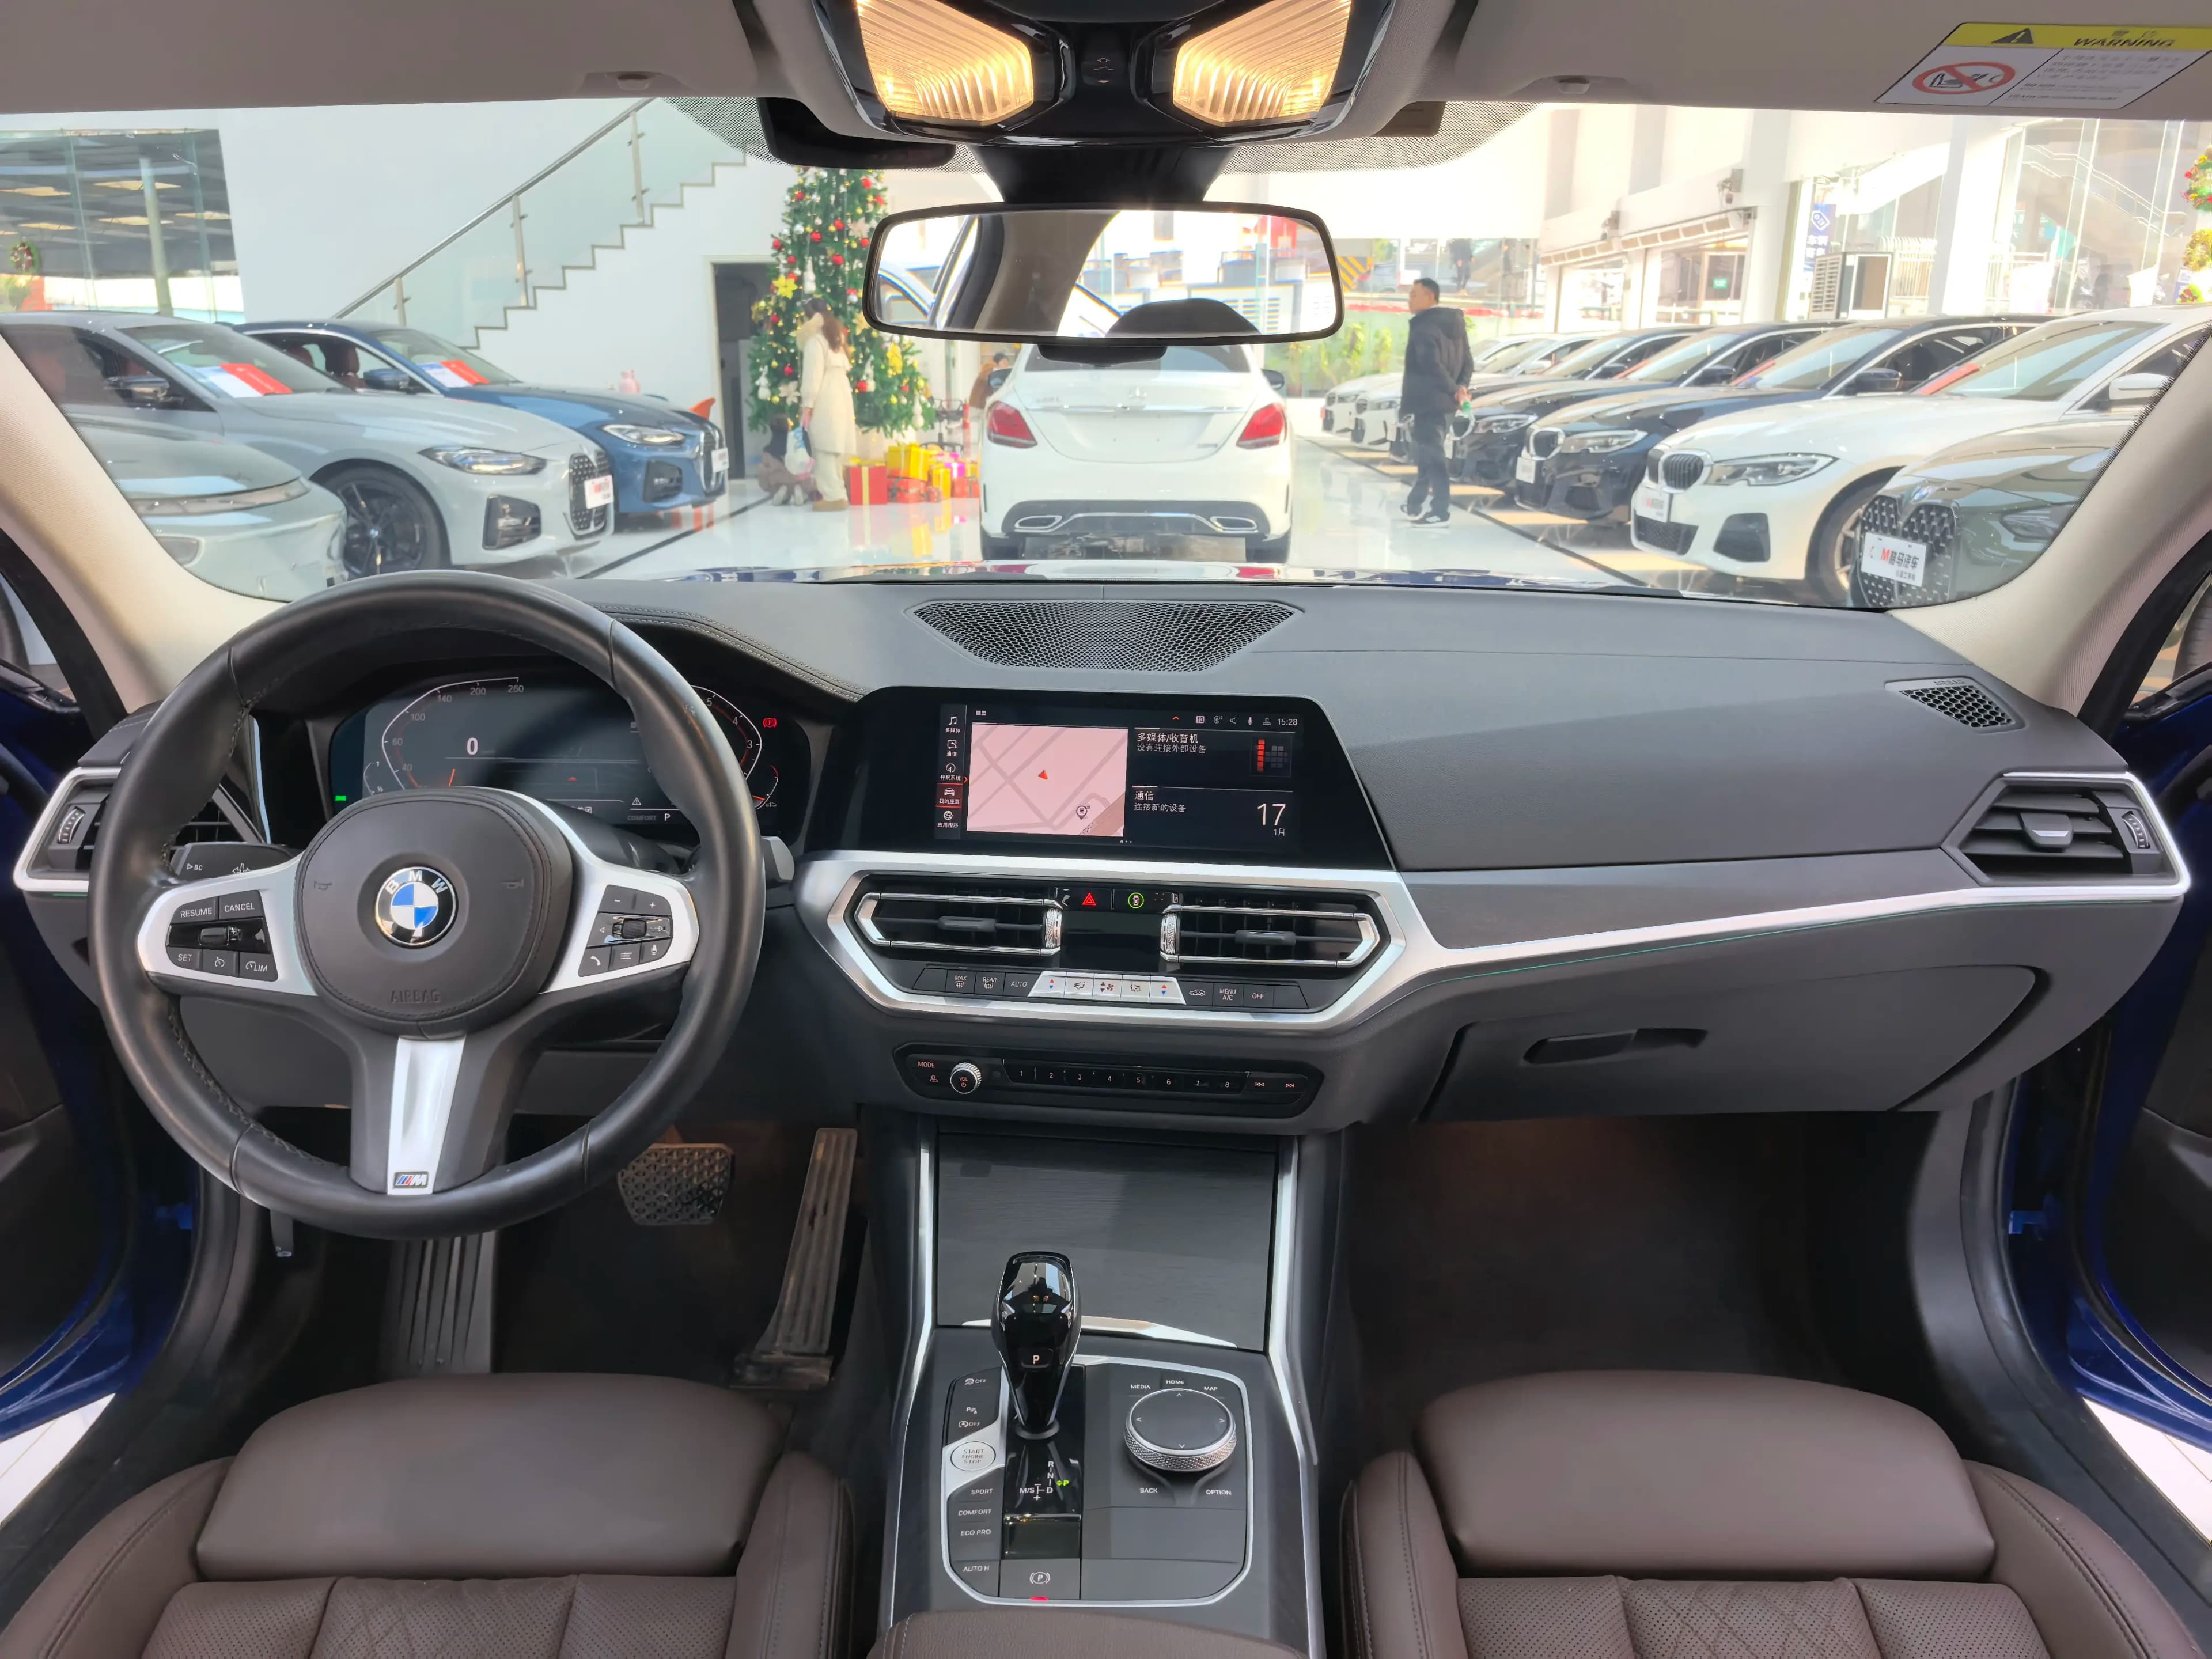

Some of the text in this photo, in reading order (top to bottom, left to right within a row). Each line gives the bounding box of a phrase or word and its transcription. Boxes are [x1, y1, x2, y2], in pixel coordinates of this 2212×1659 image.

[2074, 38, 2176, 47] WARNING
[437, 695, 452, 703] 140
[707, 698, 713, 706] 5
[733, 717, 738, 725] 4
[1137, 732, 1198, 744] 多媒体/收音机
[467, 737, 478, 755] 0
[747, 740, 752, 748] 3
[1137, 743, 1206, 753] 没有连接外部设备
[1134, 791, 1154, 800] 通信
[1134, 802, 1187, 812] 连接新的设备
[1257, 803, 1286, 825] 17
[384, 870, 448, 894] BMW
[180, 907, 213, 918] RESUME
[224, 903, 255, 913] CANCEL
[177, 953, 192, 962] SET
[254, 964, 268, 972] LIM
[391, 990, 441, 1003] AIRBAG
[1033, 1355, 1039, 1364] P
